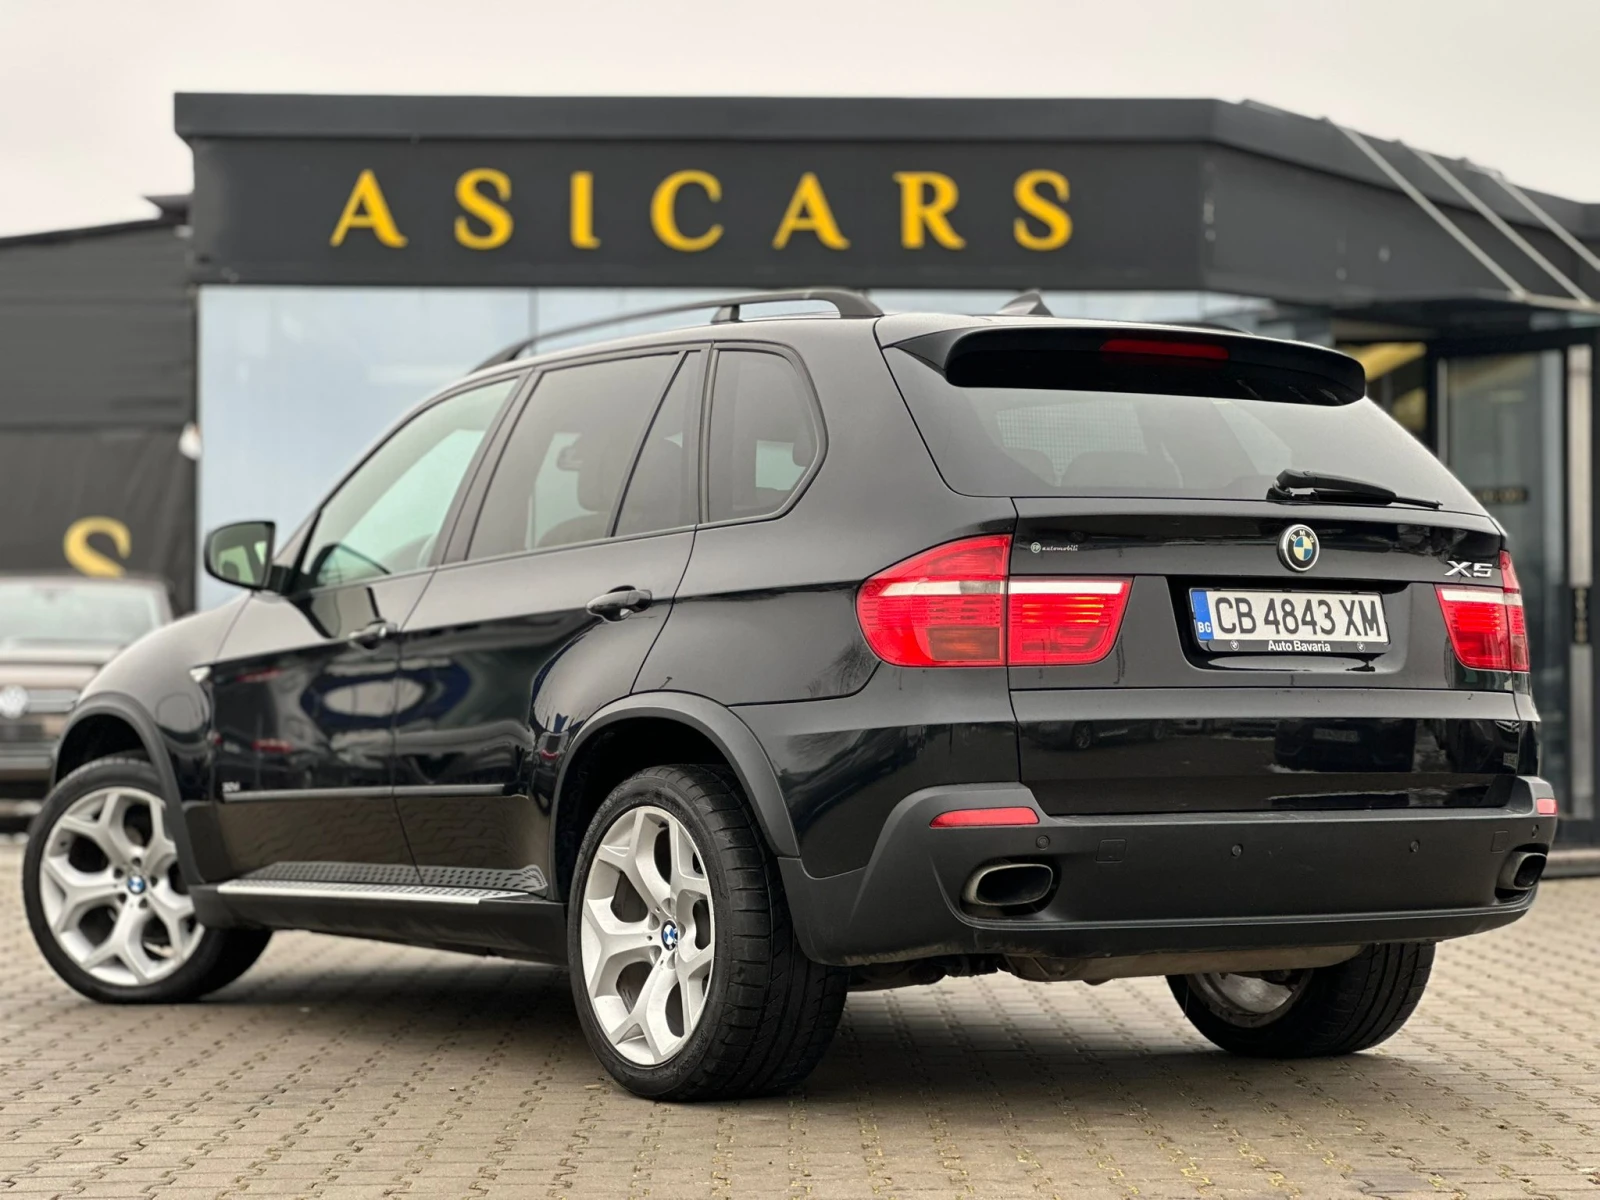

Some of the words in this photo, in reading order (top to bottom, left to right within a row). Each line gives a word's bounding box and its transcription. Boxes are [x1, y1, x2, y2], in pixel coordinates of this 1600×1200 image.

[330, 168, 1074, 252] ASICARS
[1290, 530, 1315, 543] BMW
[1444, 560, 1493, 578] X5
[1197, 622, 1212, 633] BG
[1215, 597, 1257, 634] CB
[1264, 598, 1336, 635] 4843
[1339, 599, 1382, 637] XM
[1268, 640, 1293, 652] Auto
[1294, 641, 1331, 653] Bavaria
